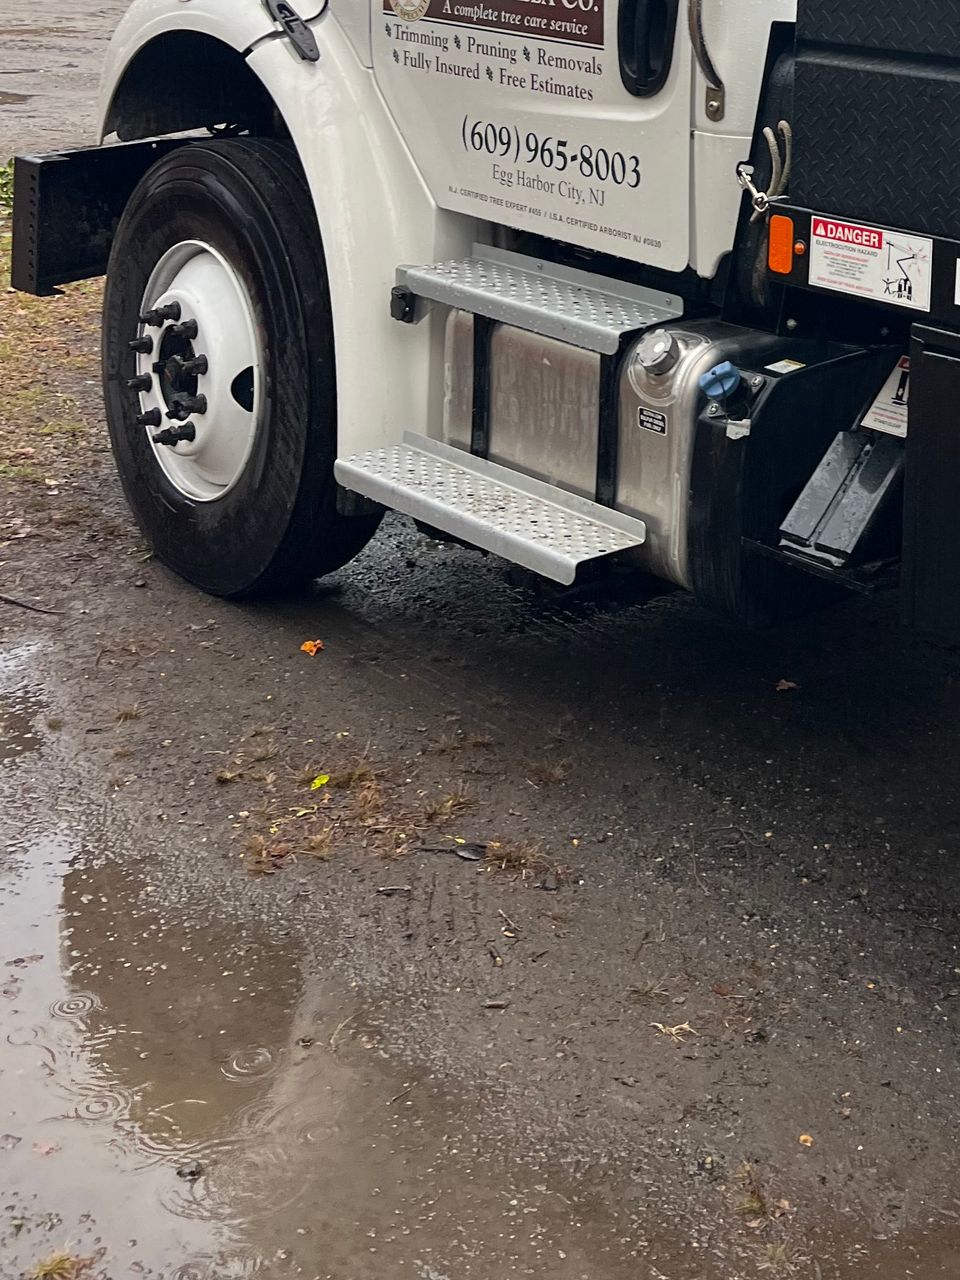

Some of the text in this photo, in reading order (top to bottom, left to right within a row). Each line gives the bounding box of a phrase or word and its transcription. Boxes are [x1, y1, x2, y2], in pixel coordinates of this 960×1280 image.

[442, 0, 589, 36] A complete tree care service
[393, 23, 603, 76] Trimming Pruning Removals
[403, 49, 594, 101] Fully Insured Free Estimates
[462, 114, 641, 189] (609) 965-8003
[492, 163, 606, 207] Egg Harbor City, NJ
[460, 188, 489, 202] CERTIFIED
[489, 196, 504, 207] TREE
[505, 200, 528, 213] EXPERT
[566, 216, 599, 232] CERTIFIED
[599, 225, 632, 241] ARBORIST
[632, 234, 642, 243] NJ
[827, 224, 879, 248] DANGER
[815, 239, 857, 253] ELECTROCUTION
[857, 247, 878, 258] HAZARD
